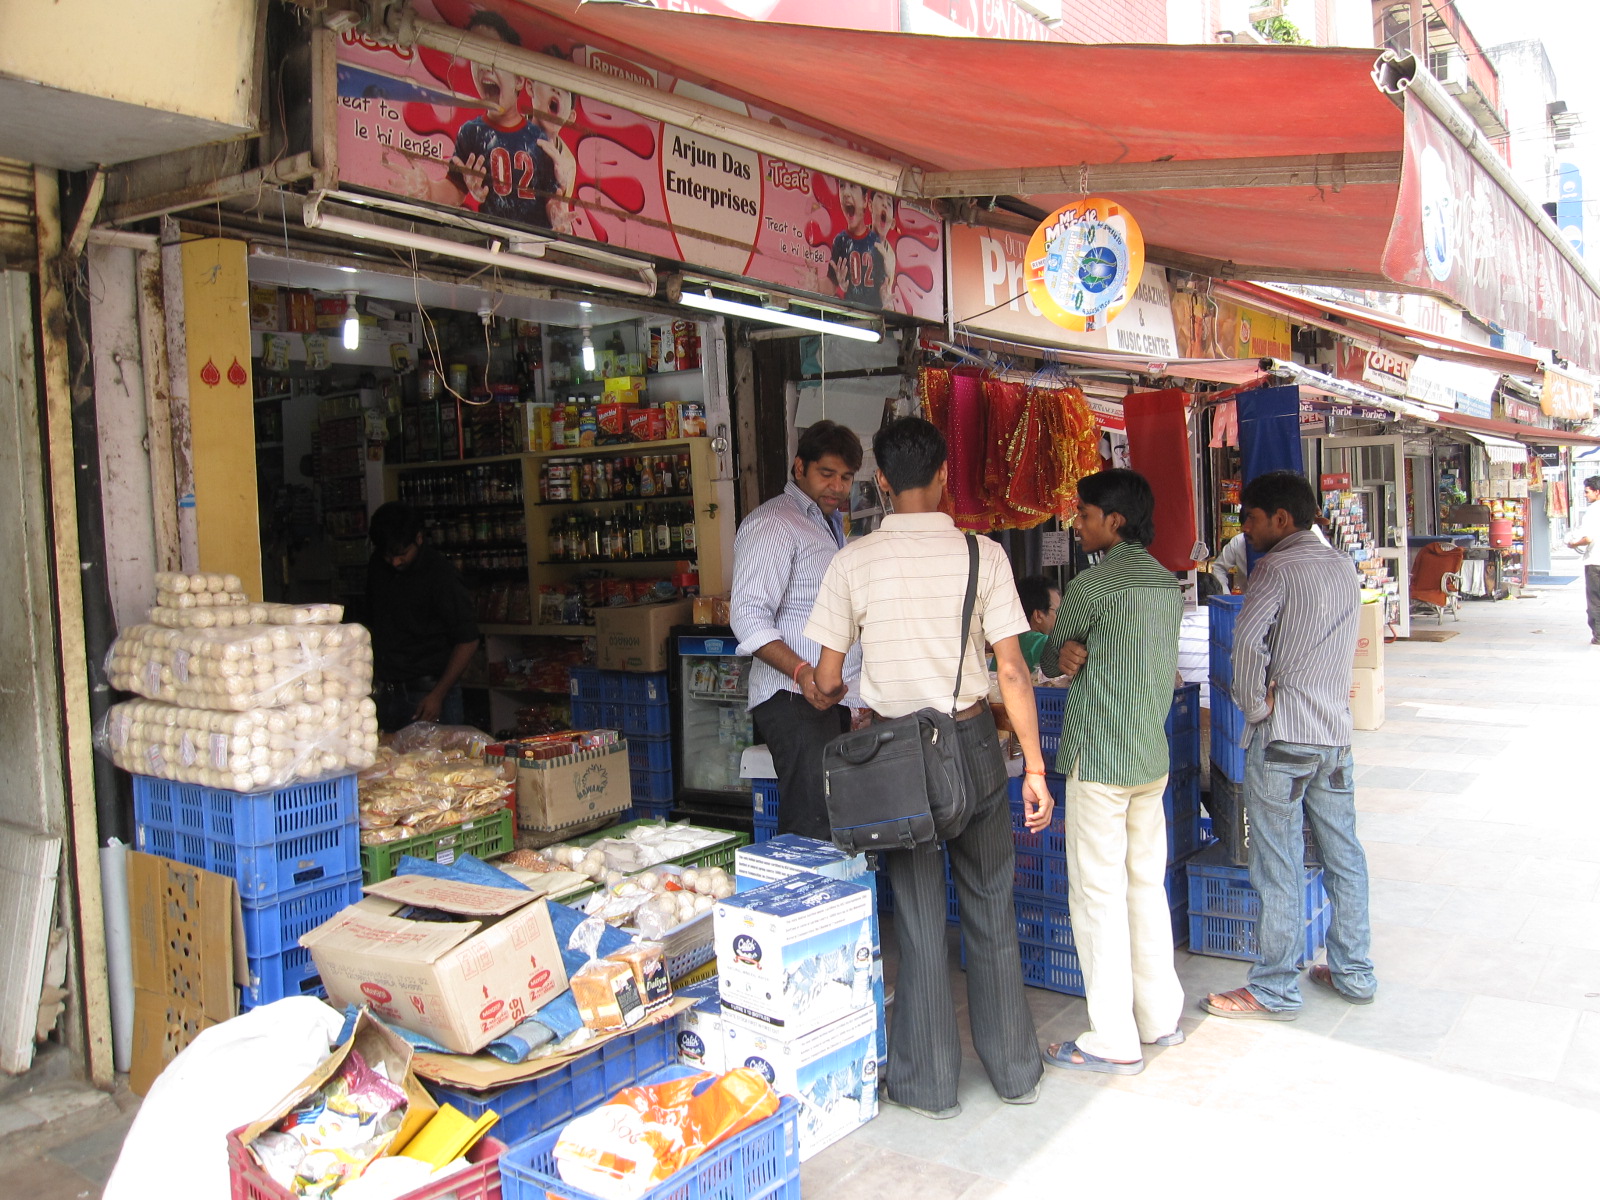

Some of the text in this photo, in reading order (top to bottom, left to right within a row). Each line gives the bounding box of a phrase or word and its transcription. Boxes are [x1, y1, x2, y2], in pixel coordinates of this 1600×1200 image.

[380, 100, 399, 120] to
[355, 119, 442, 160] le hi lenge!
[672, 135, 750, 180] Arjun Das
[490, 147, 536, 199] 02
[768, 160, 810, 195] Treat
[666, 169, 757, 216] Enterprises
[765, 216, 803, 238] Treat to
[1059, 209, 1077, 224] Mr
[780, 243, 787, 254] le
[791, 243, 799, 256] hi
[850, 251, 874, 287] 02
[1134, 283, 1168, 308] MAGAZINE
[1138, 308, 1145, 327] &
[1117, 329, 1171, 356] MUSIC CENTRE
[1371, 352, 1411, 381] OPEN
[1361, 408, 1387, 420] Forbes
[737, 937, 757, 952] Catch
